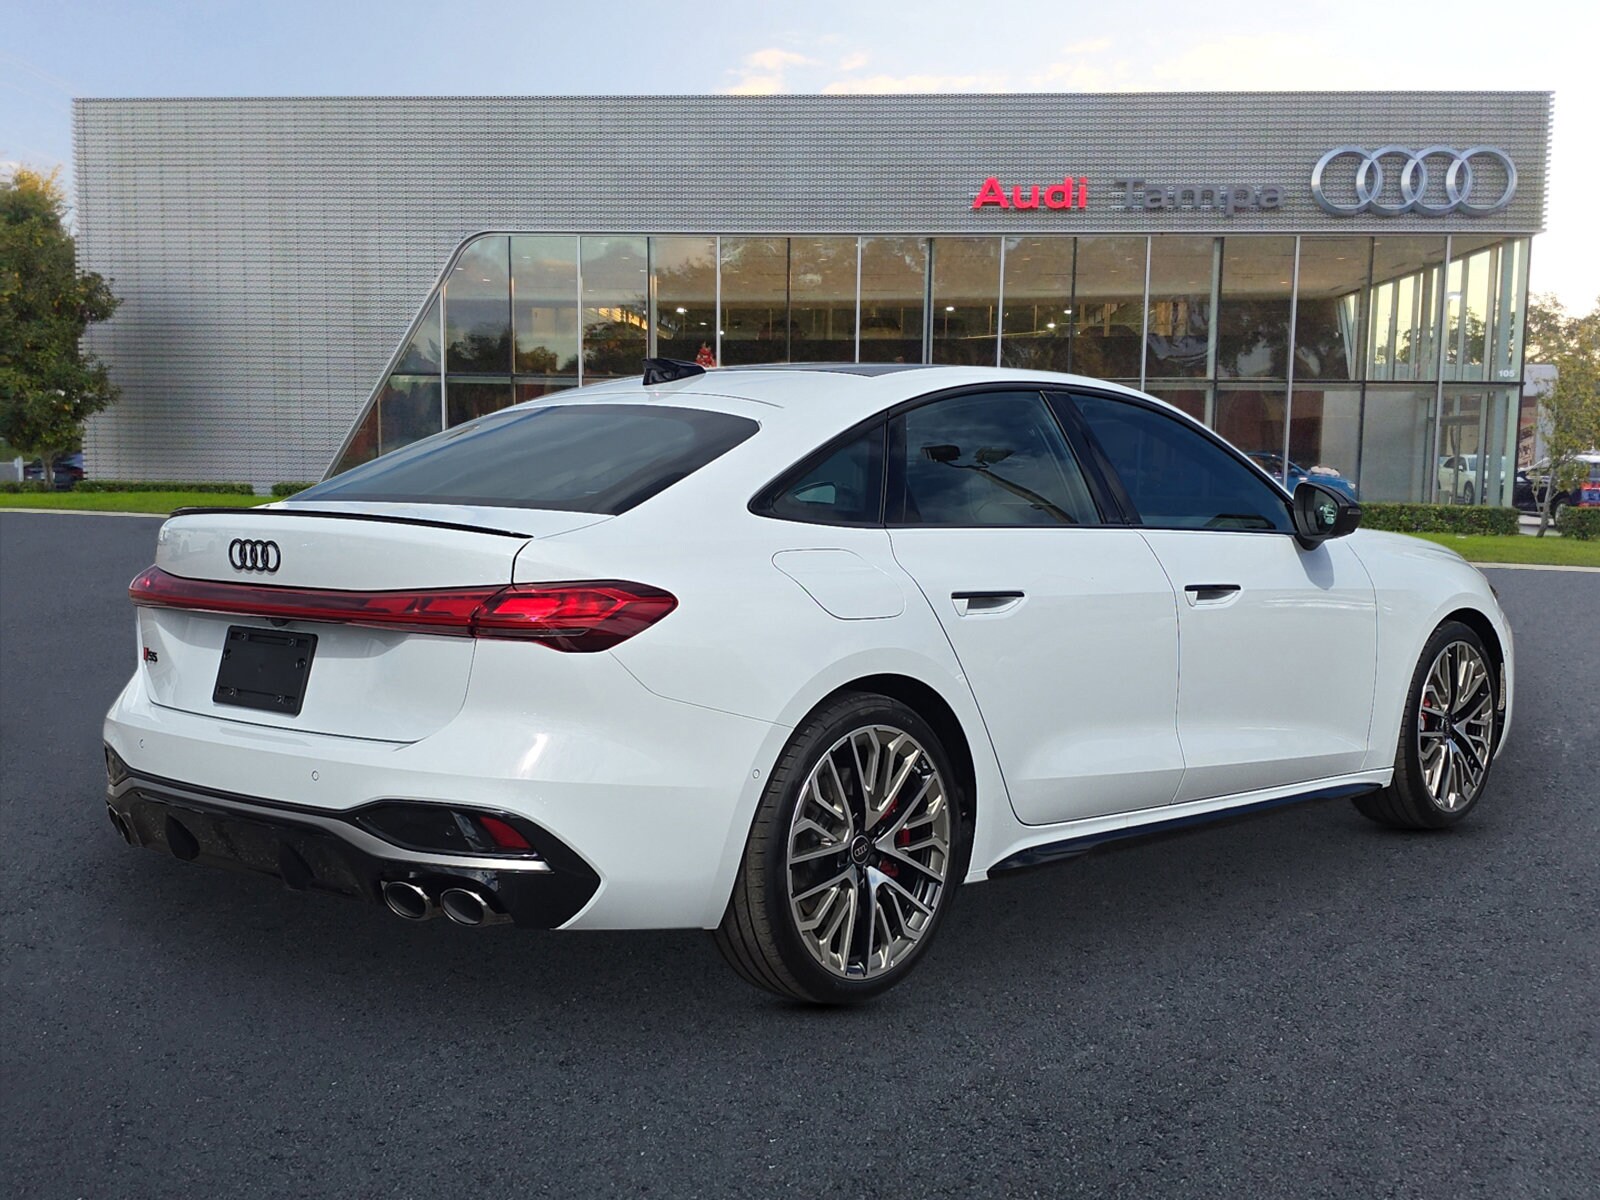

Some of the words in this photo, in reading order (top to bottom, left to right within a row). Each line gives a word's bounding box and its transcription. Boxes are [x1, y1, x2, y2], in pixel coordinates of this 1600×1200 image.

[972, 176, 1087, 209] Audi
[1113, 178, 1285, 218] Tampa
[1499, 369, 1515, 378] 105
